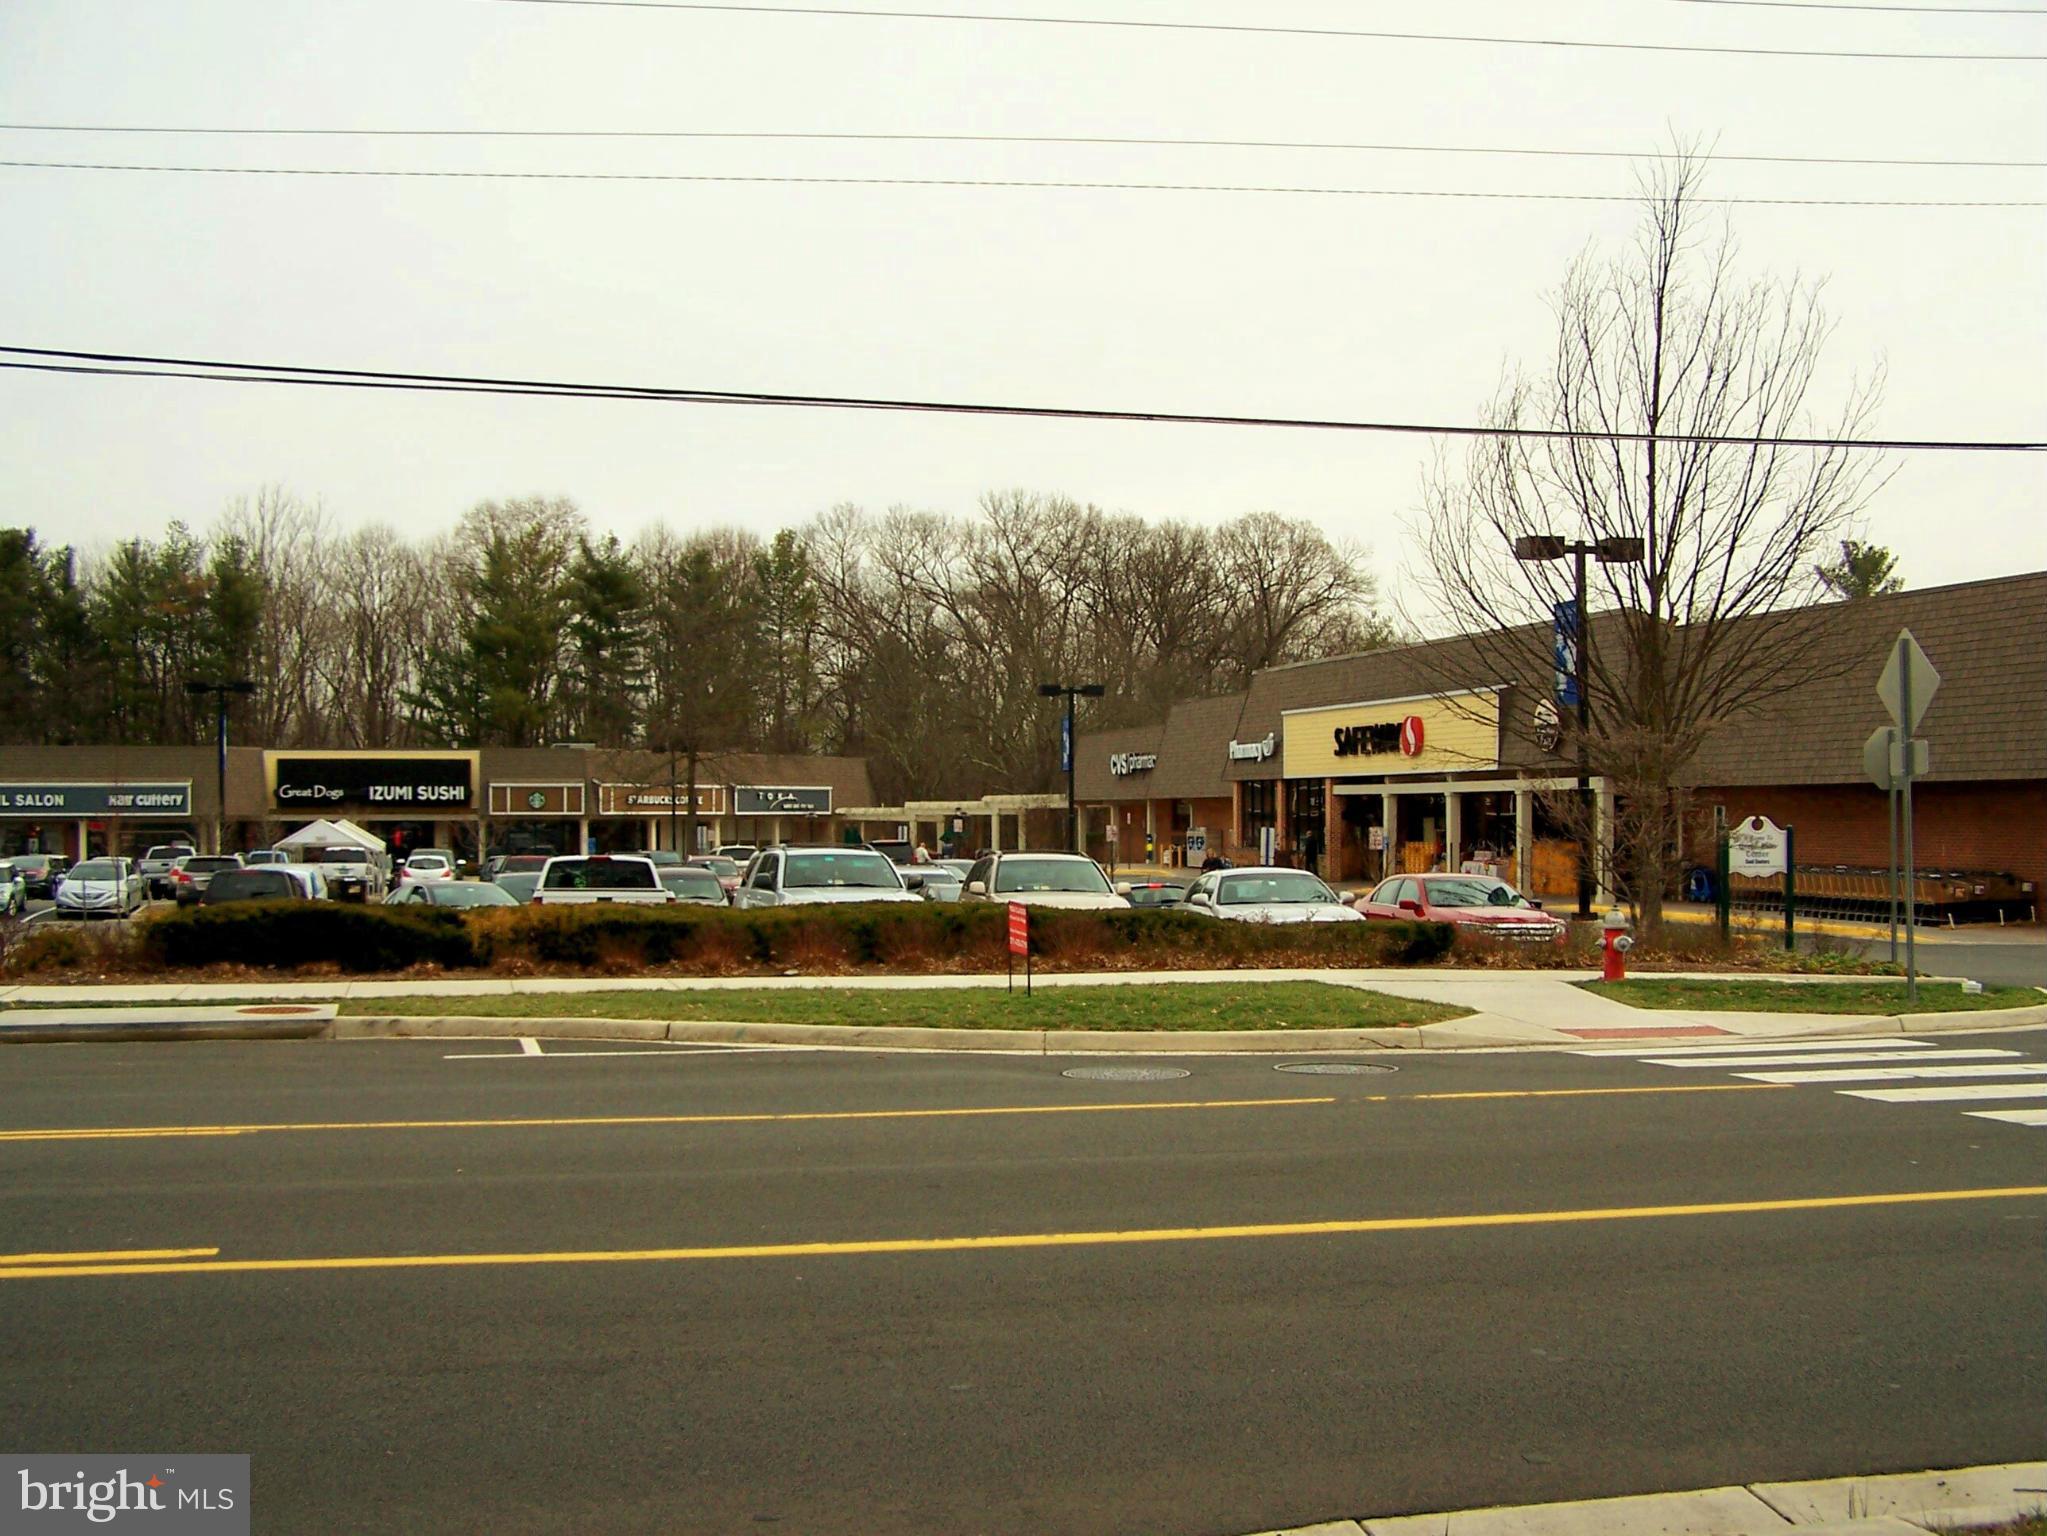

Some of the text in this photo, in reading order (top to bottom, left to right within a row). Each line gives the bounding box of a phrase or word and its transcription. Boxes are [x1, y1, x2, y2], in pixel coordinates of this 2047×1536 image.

[279, 784, 344, 800] Great Dogs
[368, 785, 465, 800] IZUMI SUSHI
[15, 793, 65, 807] SALON
[675, 794, 704, 805] COFE
